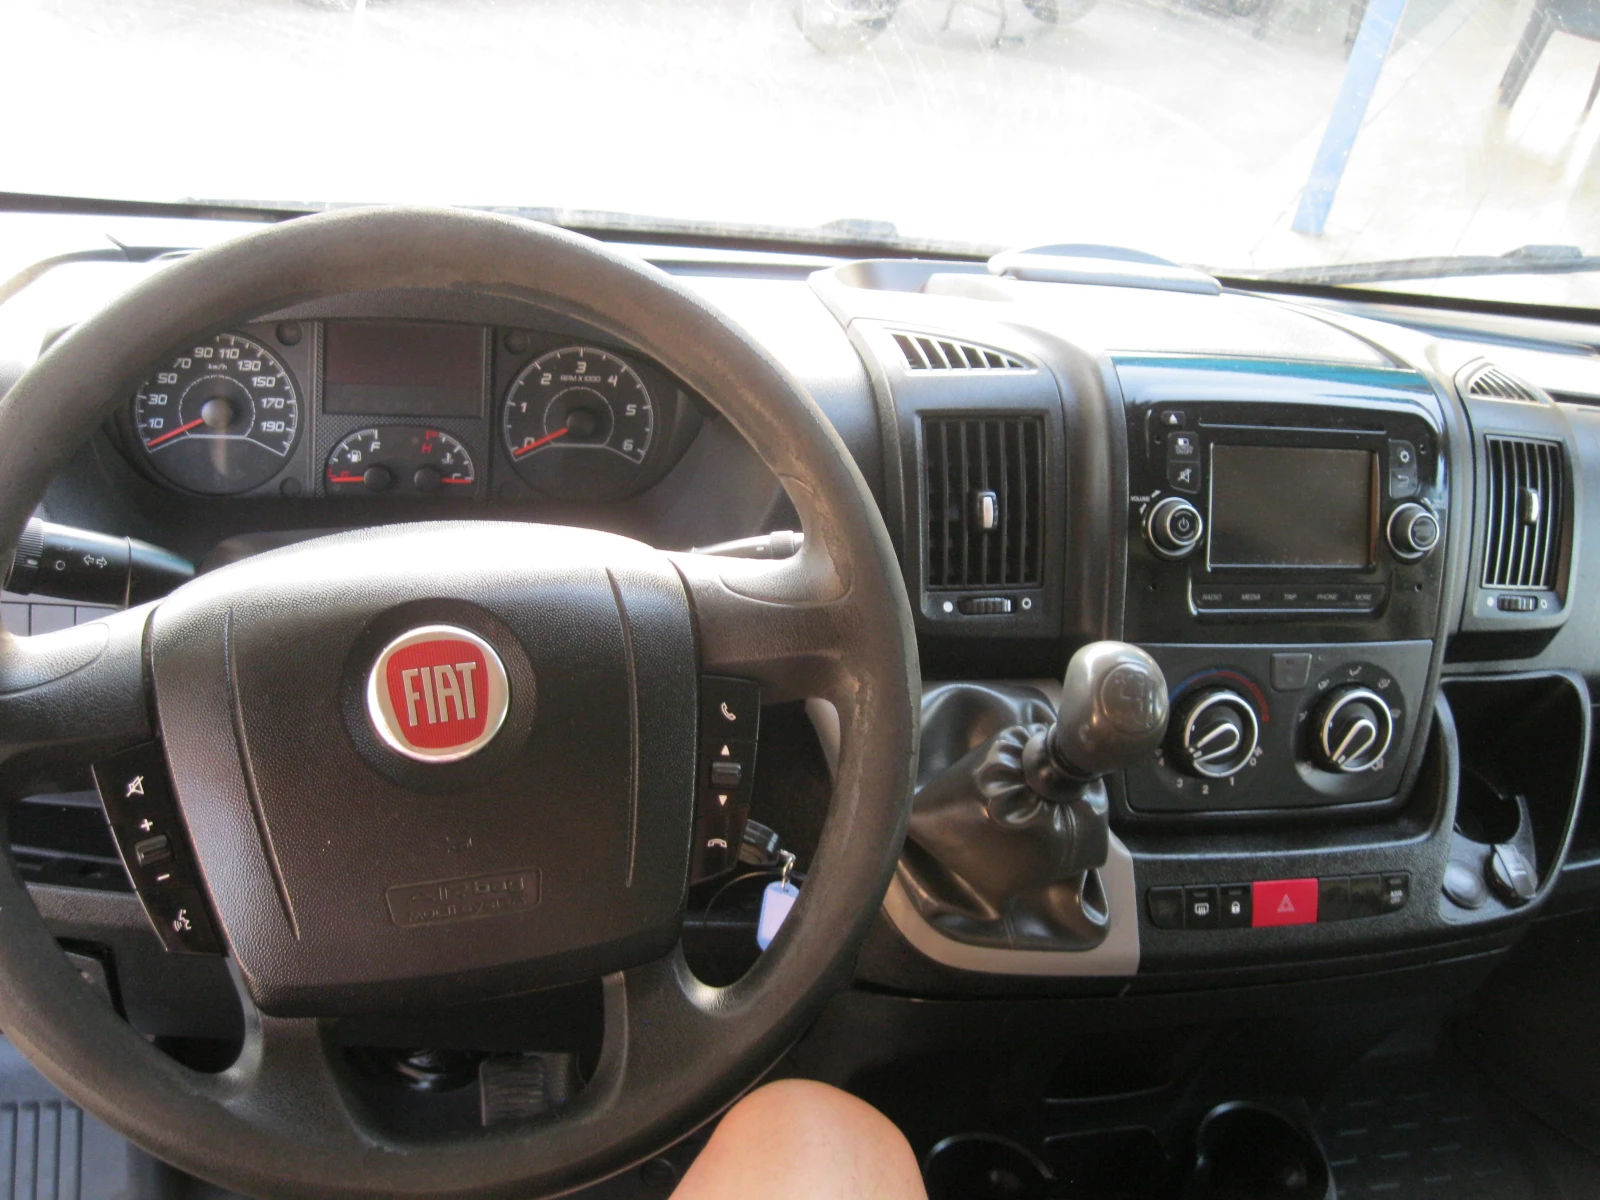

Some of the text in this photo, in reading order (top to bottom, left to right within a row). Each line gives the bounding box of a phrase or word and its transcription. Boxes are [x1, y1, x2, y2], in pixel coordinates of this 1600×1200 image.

[194, 347, 213, 358] 90
[218, 348, 239, 360] 110
[173, 357, 192, 369] 70
[237, 360, 261, 372] 130
[575, 361, 587, 374] 3
[157, 372, 178, 384] 50
[252, 376, 276, 387] 150
[540, 373, 552, 386] 2
[607, 375, 618, 387] 4
[148, 394, 168, 405] 30
[261, 398, 285, 409] 170
[520, 402, 527, 413] 1
[625, 404, 637, 416] 5
[148, 417, 164, 429] 10
[260, 421, 285, 432] 190
[370, 441, 381, 453] F
[421, 443, 432, 454] H
[622, 439, 634, 451] 6
[402, 661, 477, 727] FIAT
[1176, 778, 1183, 788] 3
[1202, 784, 1209, 795] 2
